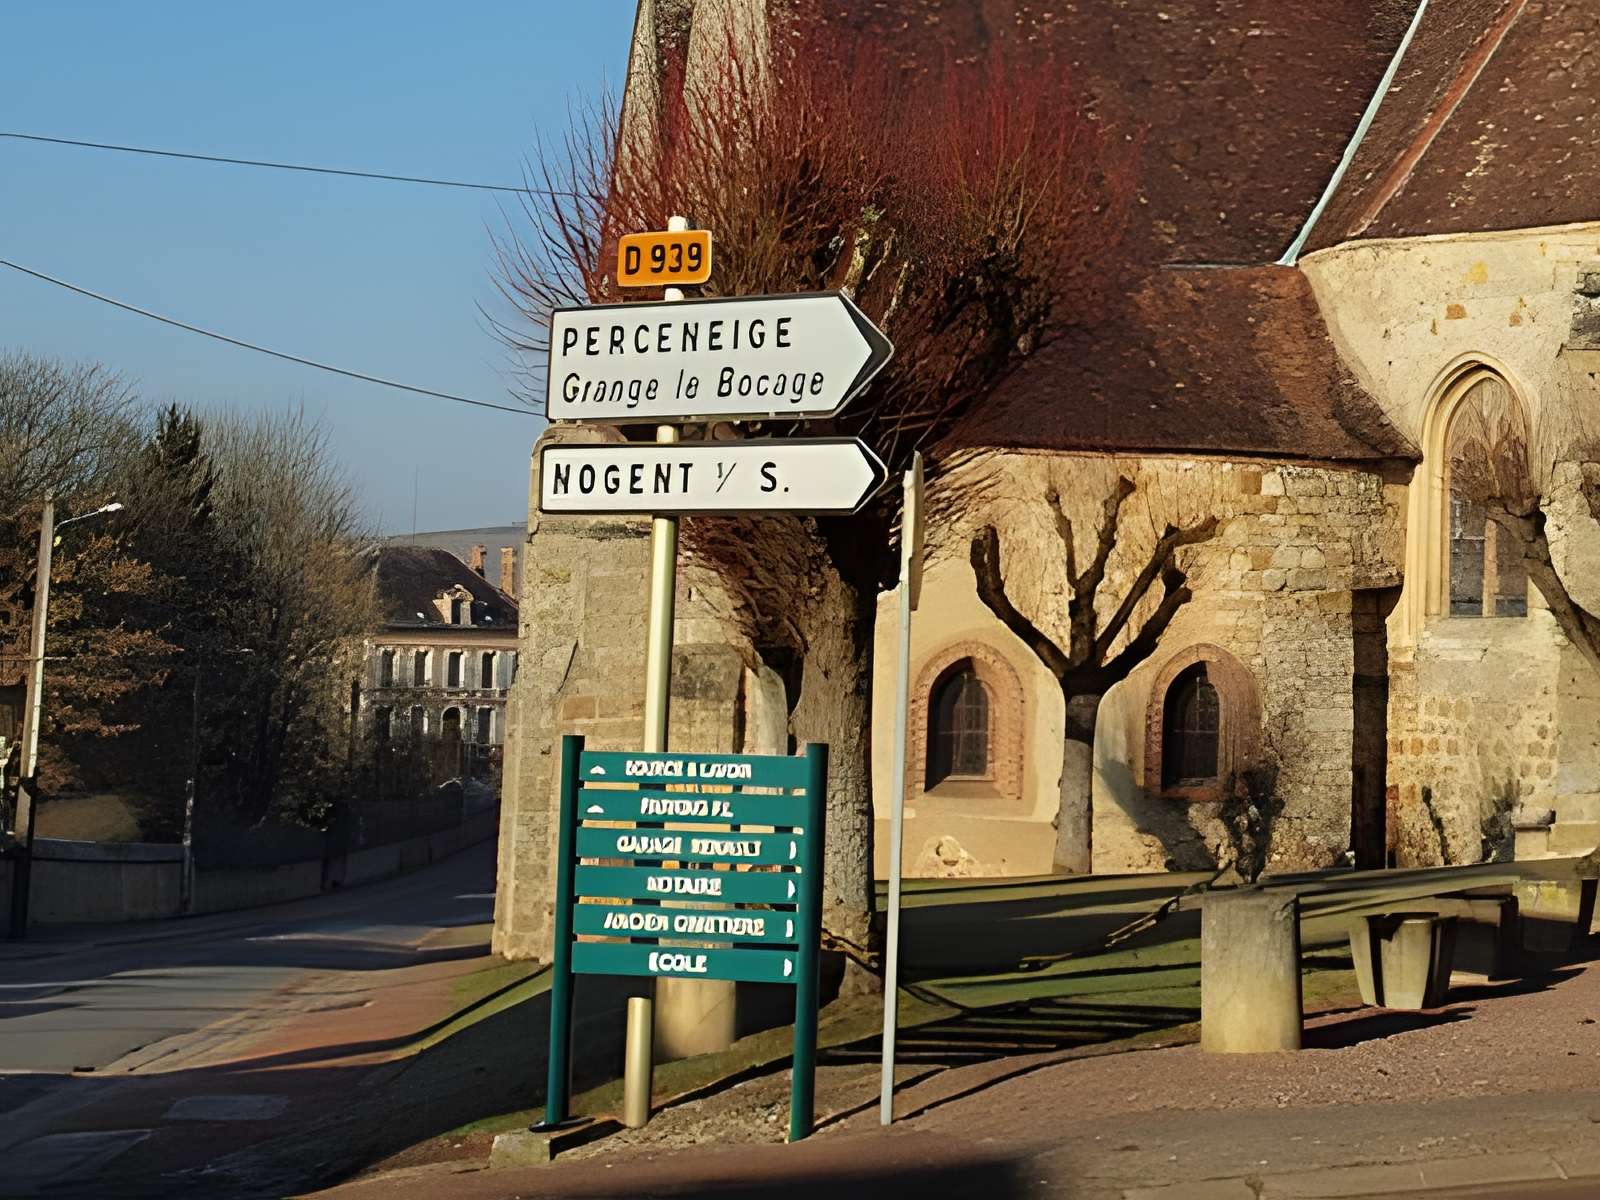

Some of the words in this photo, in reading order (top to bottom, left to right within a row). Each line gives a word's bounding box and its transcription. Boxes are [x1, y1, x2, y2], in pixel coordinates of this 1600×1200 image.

[624, 245, 641, 275] D
[650, 242, 702, 274] 939
[562, 316, 792, 356] PERCENEIGE
[561, 372, 659, 408] Grange
[676, 369, 699, 399] le
[717, 366, 825, 403] Bocage
[552, 462, 693, 495] NOGENT
[760, 461, 790, 493] S.
